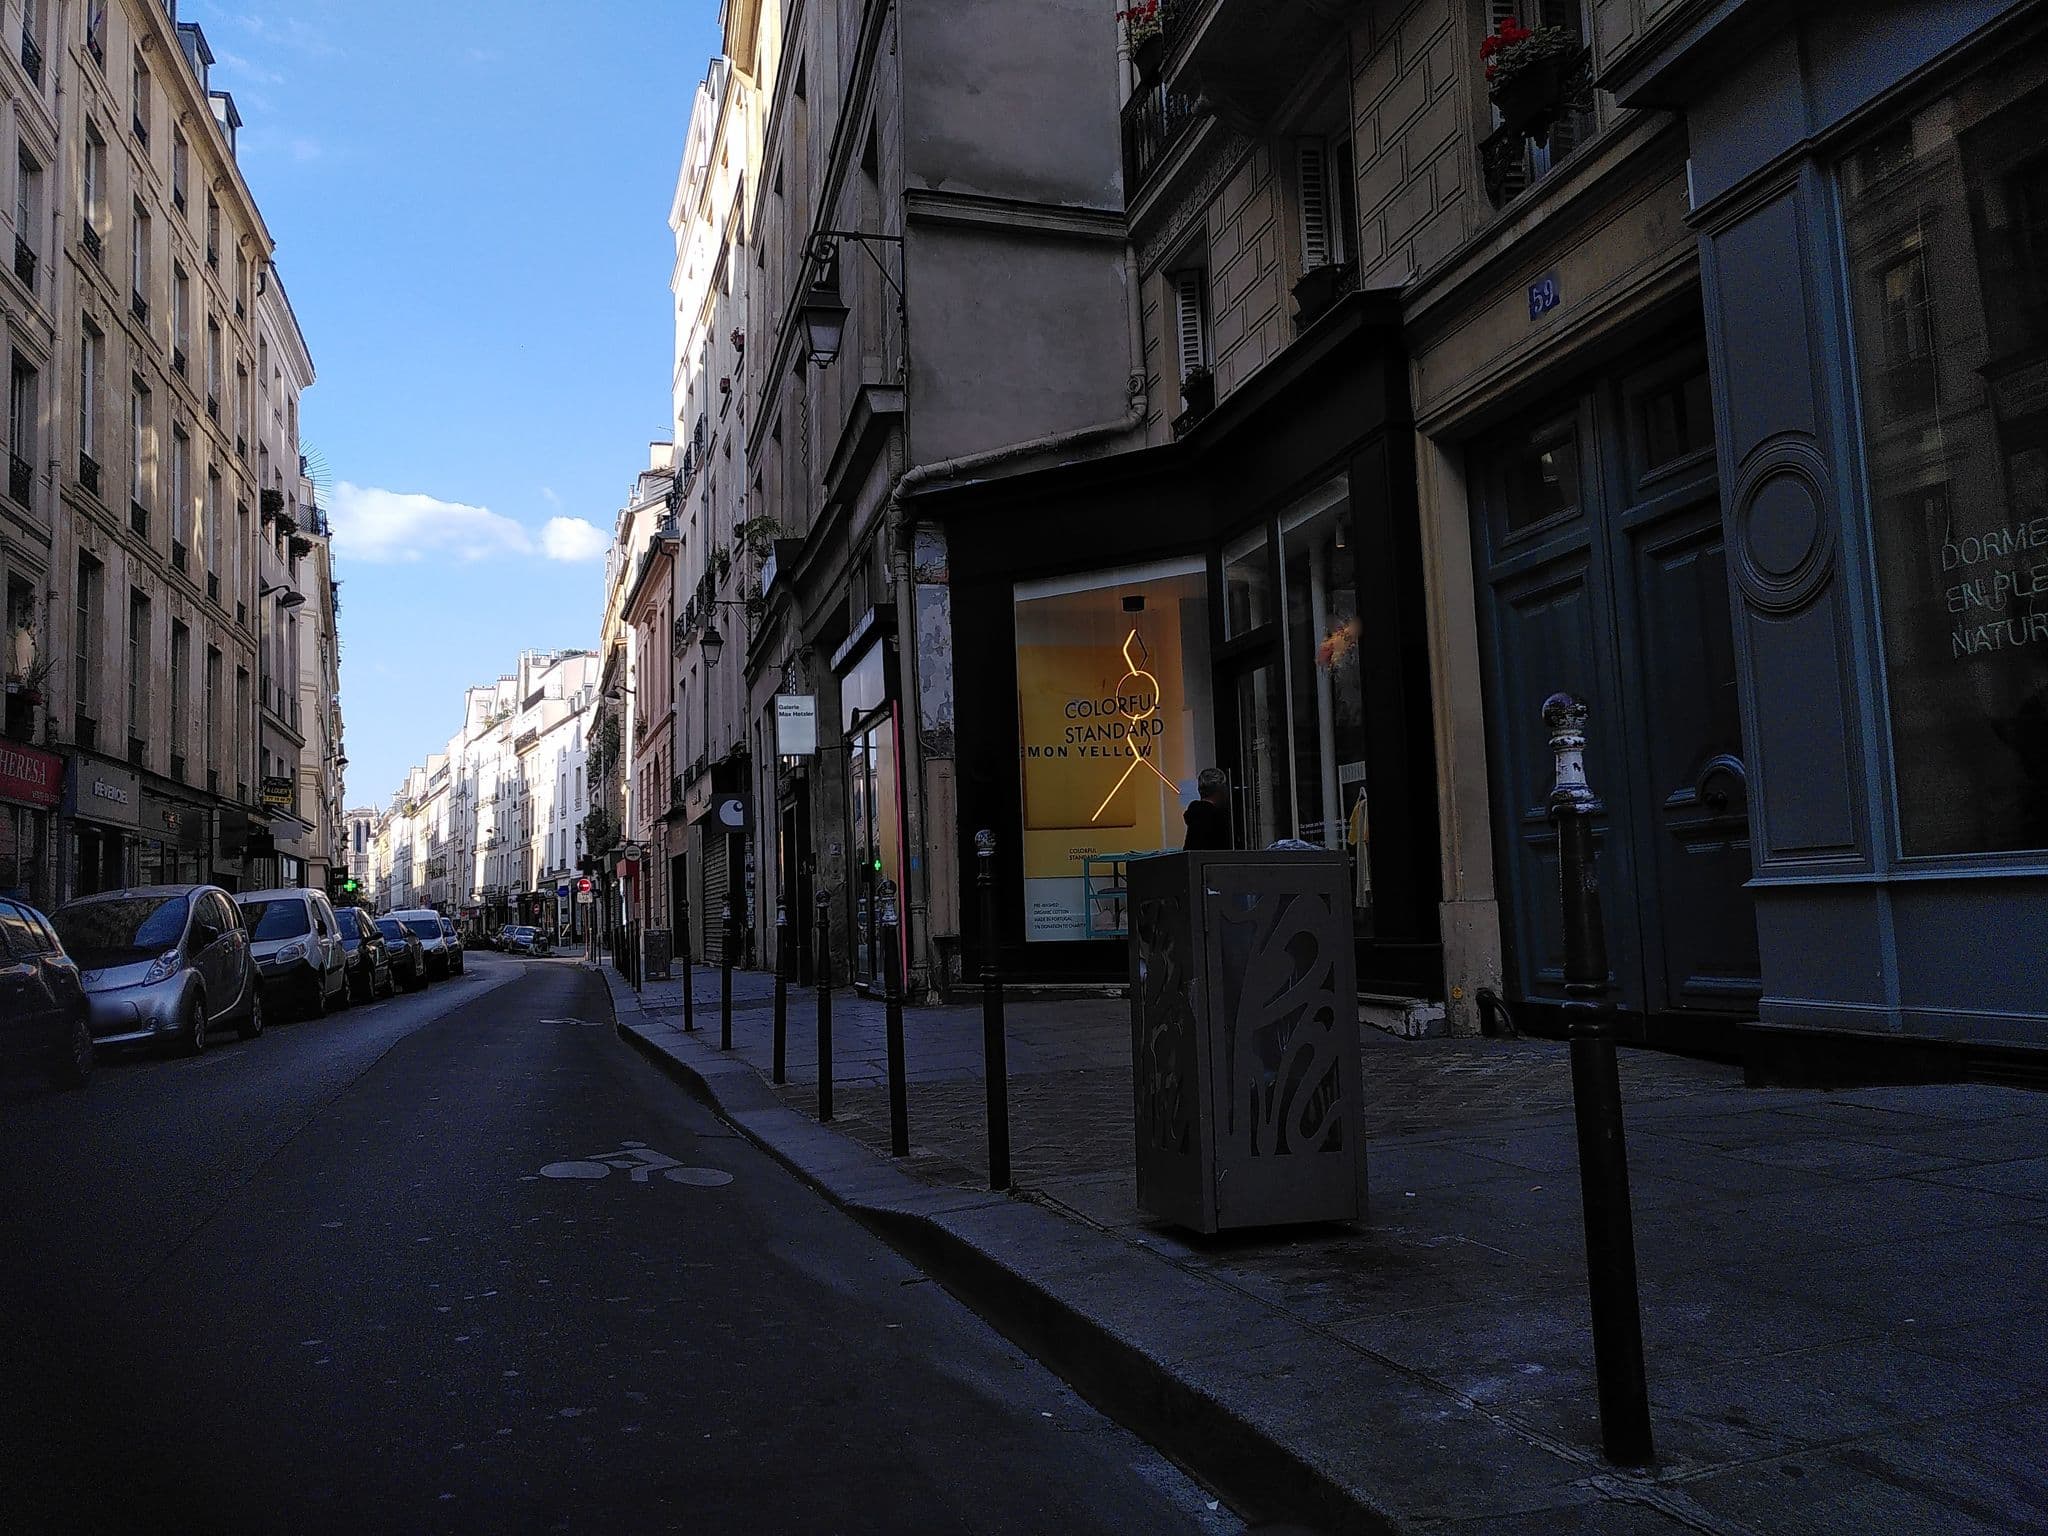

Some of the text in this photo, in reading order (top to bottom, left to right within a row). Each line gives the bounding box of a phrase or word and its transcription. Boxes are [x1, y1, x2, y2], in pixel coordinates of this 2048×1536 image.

[1533, 280, 1553, 312] 59
[1065, 694, 1161, 719] COLORFUL
[1065, 718, 1164, 744] STANDARD
[1078, 746, 1153, 757] YELLOW
